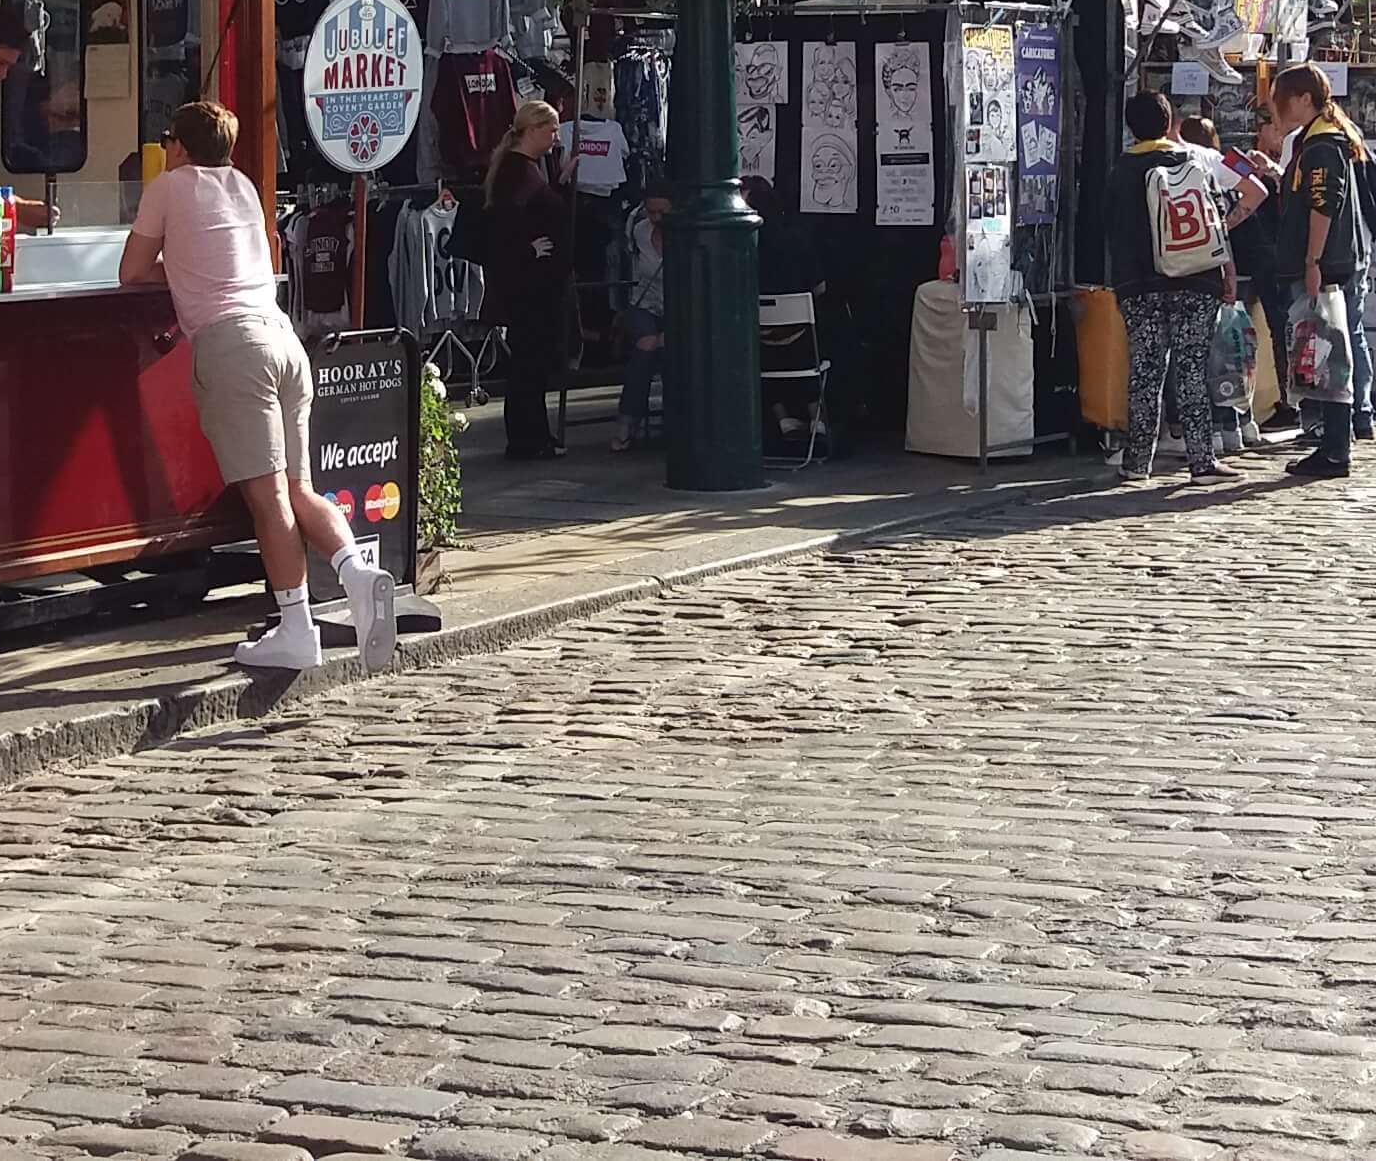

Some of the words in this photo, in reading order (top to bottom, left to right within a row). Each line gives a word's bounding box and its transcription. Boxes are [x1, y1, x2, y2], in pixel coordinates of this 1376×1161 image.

[326, 27, 406, 59] JUBILEE
[324, 54, 407, 90] MARKET
[326, 103, 363, 113] COVENT
[368, 102, 404, 111] GARDEN
[340, 95, 357, 103] THE
[361, 94, 389, 102] HEART
[579, 142, 608, 152] ONDON
[1168, 200, 1201, 240] B
[318, 359, 402, 385] HOORAY'S
[317, 383, 357, 397] GERMAN
[359, 380, 377, 392] HOT
[379, 377, 402, 390] DOGS
[321, 443, 344, 471] We
[347, 436, 398, 468] accept
